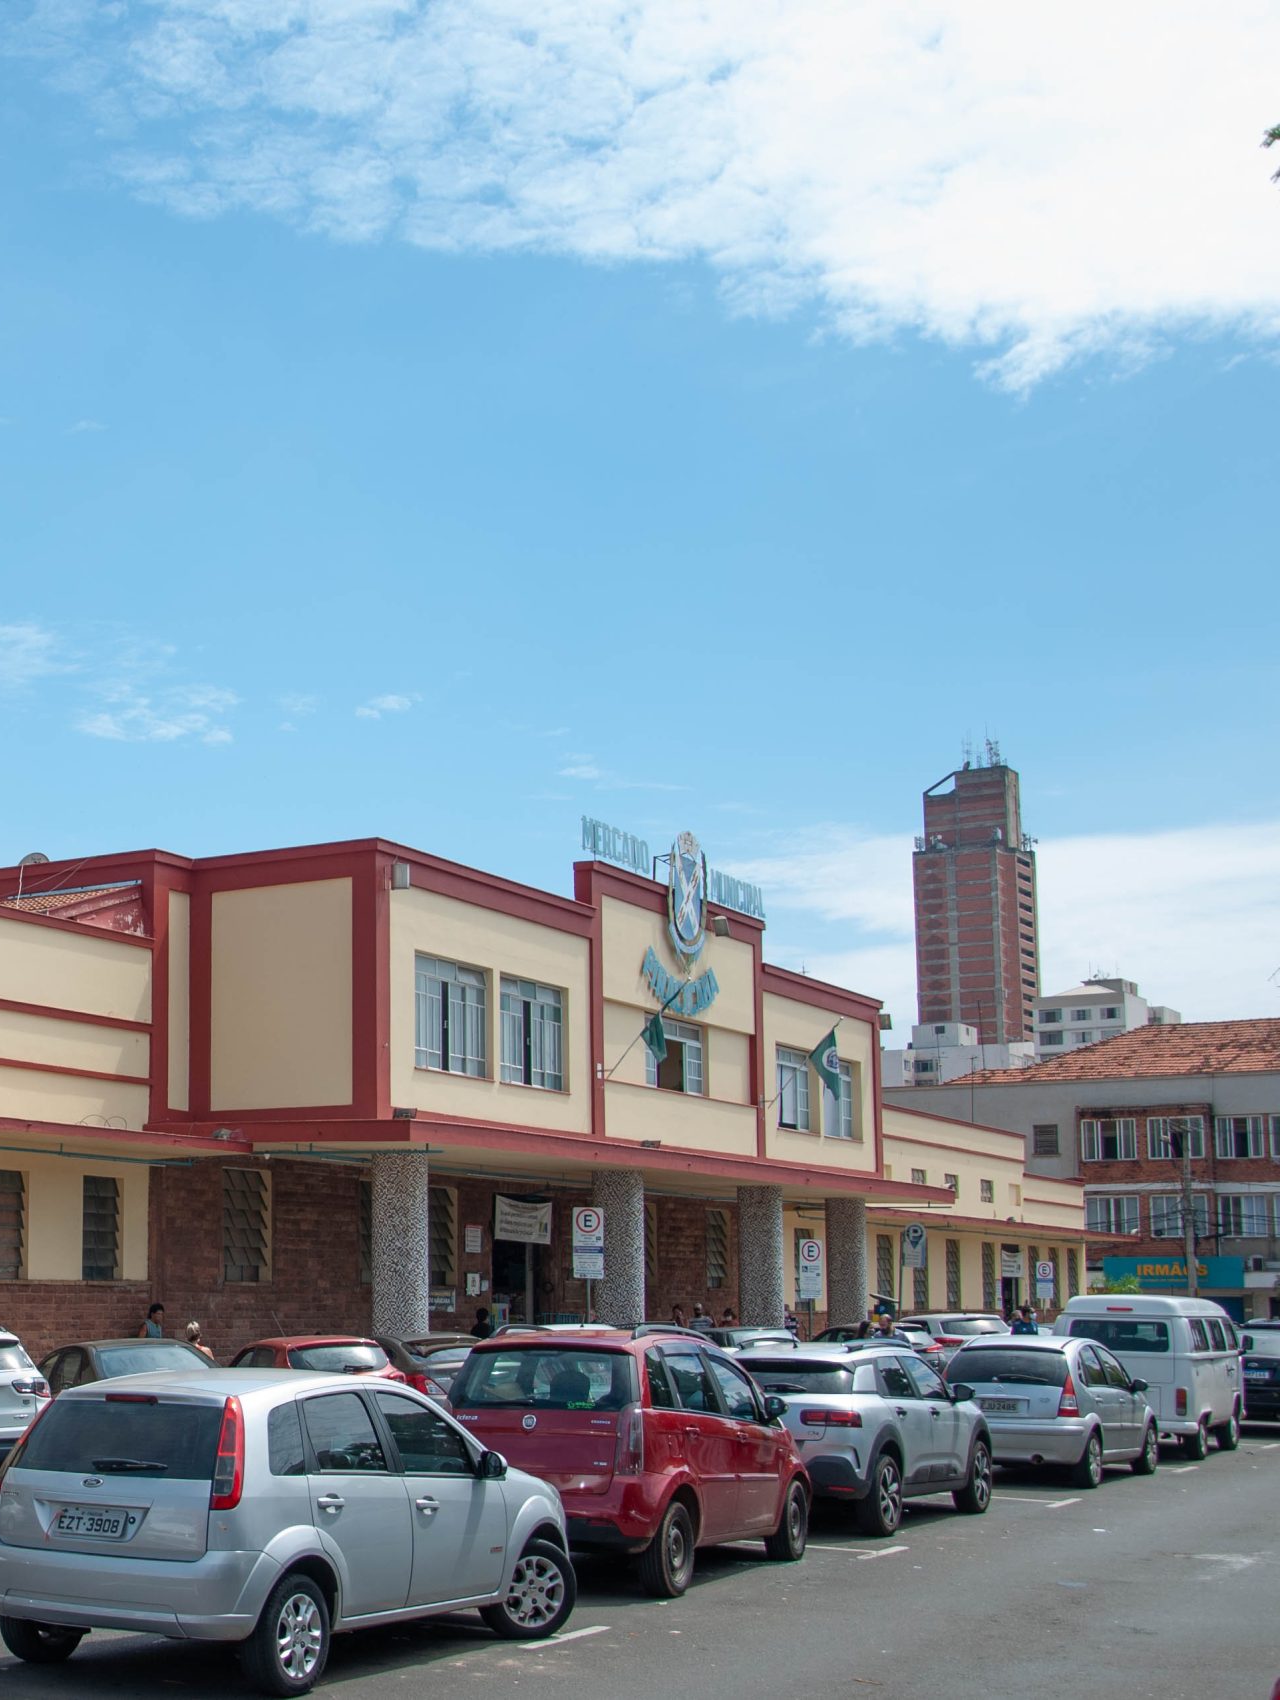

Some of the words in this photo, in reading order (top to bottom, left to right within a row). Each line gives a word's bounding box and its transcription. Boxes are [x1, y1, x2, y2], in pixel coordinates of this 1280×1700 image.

[582, 815, 650, 874] MERCADO
[710, 868, 765, 918] MUNICIPAL
[583, 1214, 593, 1228] E
[909, 1227, 922, 1241] P
[807, 1245, 815, 1258] E
